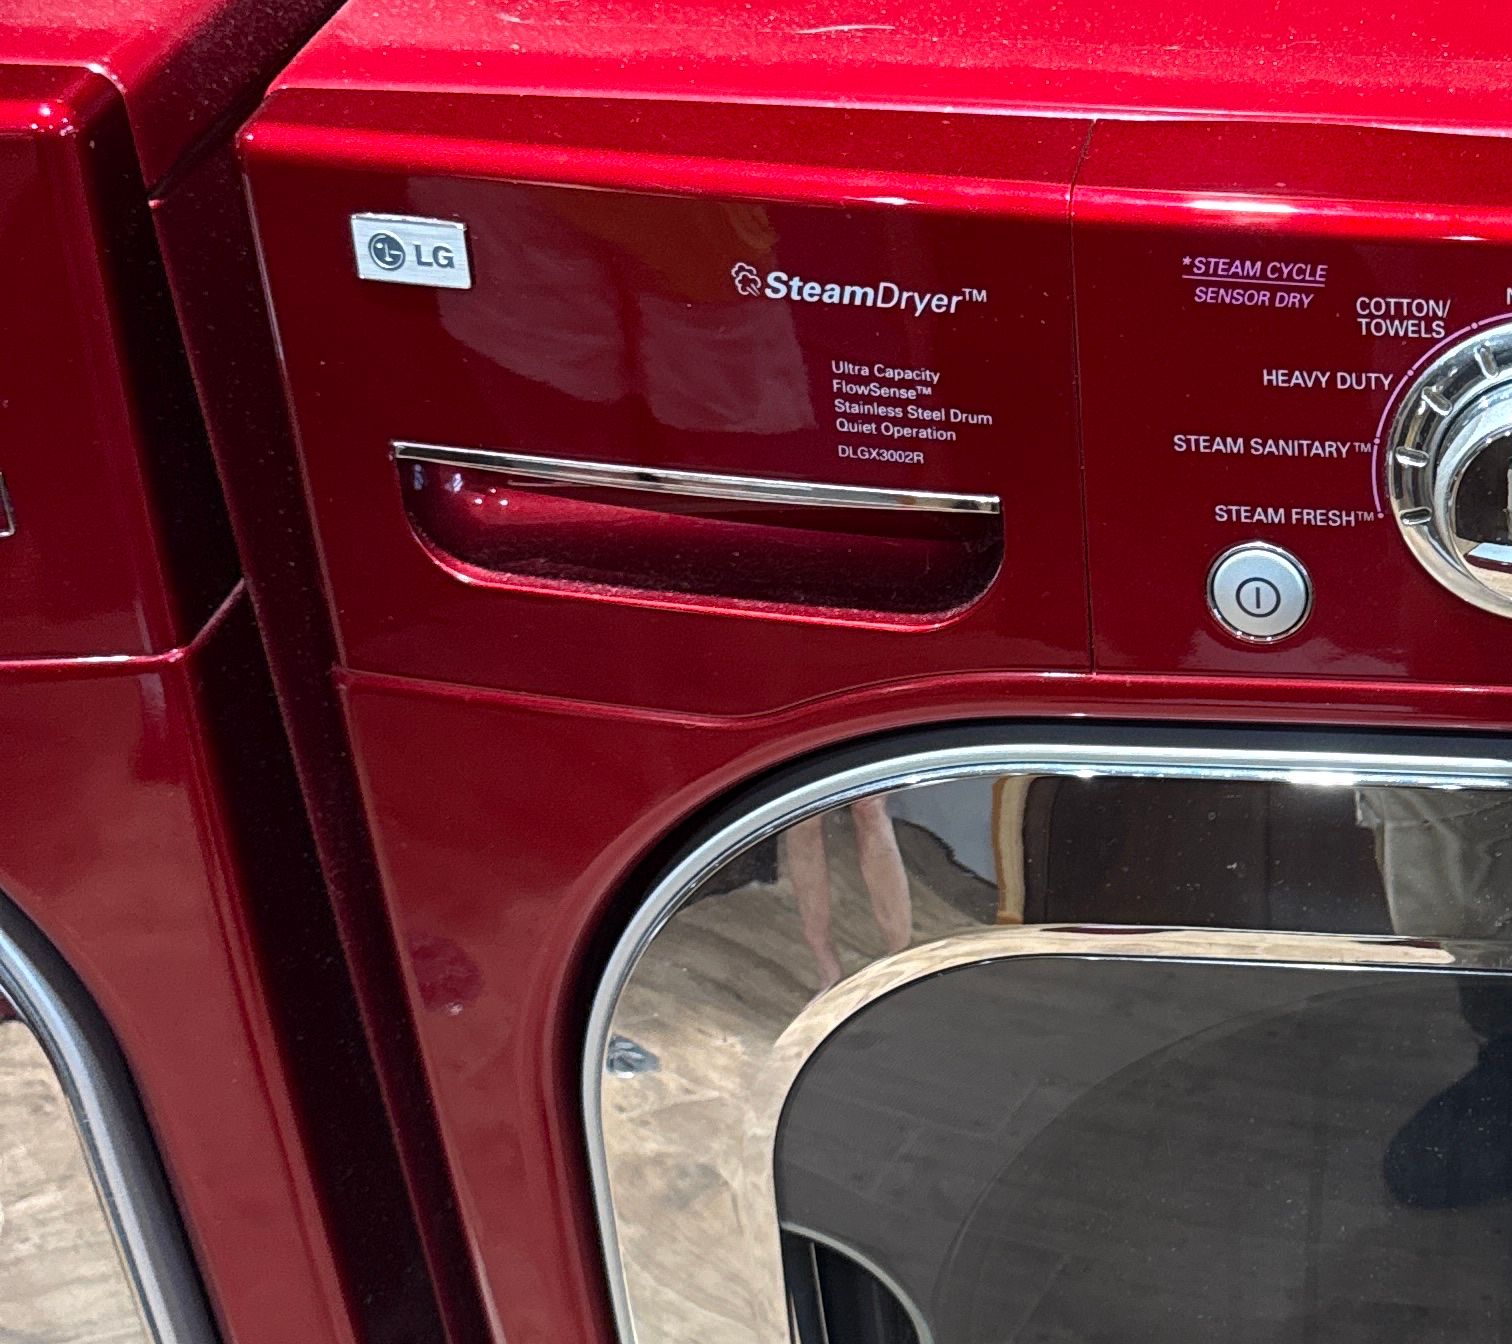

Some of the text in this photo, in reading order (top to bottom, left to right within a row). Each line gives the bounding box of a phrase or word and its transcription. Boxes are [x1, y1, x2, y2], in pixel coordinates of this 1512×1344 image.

[414, 243, 455, 269] LG
[1266, 262, 1329, 282] CYCLE
[1194, 286, 1314, 309] SENSOR DRY
[1356, 297, 1451, 319] COTTON/
[1357, 318, 1445, 339] TOWELS
[832, 360, 940, 384] Ultra Capacity
[1263, 369, 1393, 391] HEAVY DUTY
[834, 399, 993, 425] Stainless Steel Drum
[836, 417, 957, 441] Quiet Operation
[838, 444, 925, 464] DLGX3002R
[1173, 435, 1244, 455] STEAM
[1215, 505, 1285, 524] STEAM
